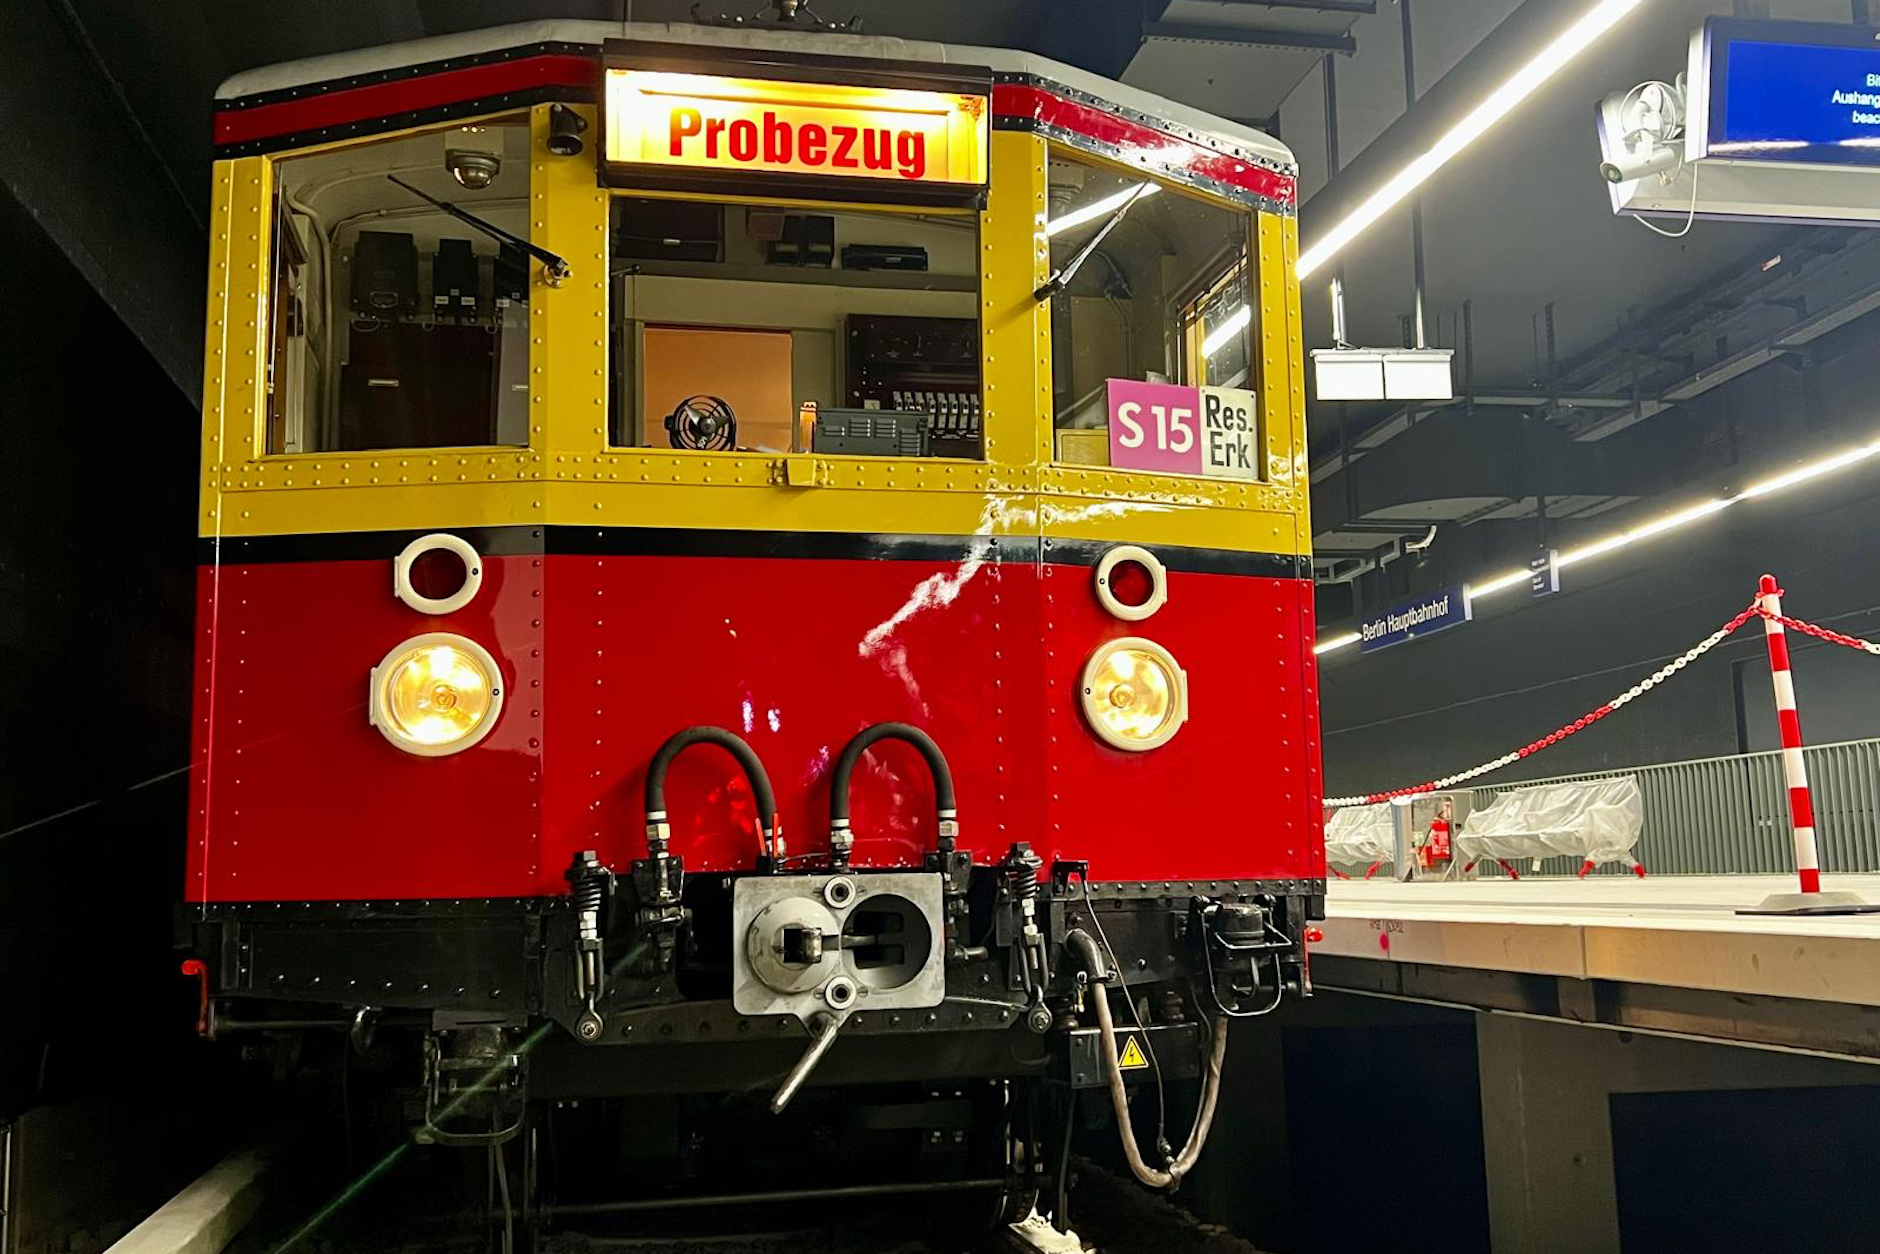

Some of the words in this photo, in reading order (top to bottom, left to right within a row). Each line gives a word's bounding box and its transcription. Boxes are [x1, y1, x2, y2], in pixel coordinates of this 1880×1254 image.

[669, 107, 925, 179] Probezug
[1117, 401, 1145, 448] S
[1151, 405, 1194, 453] 15
[1205, 394, 1253, 433] Res.
[1210, 431, 1251, 469] Erk
[1362, 618, 1388, 642] Berlin
[1386, 595, 1449, 633] Hauptbahnhof
